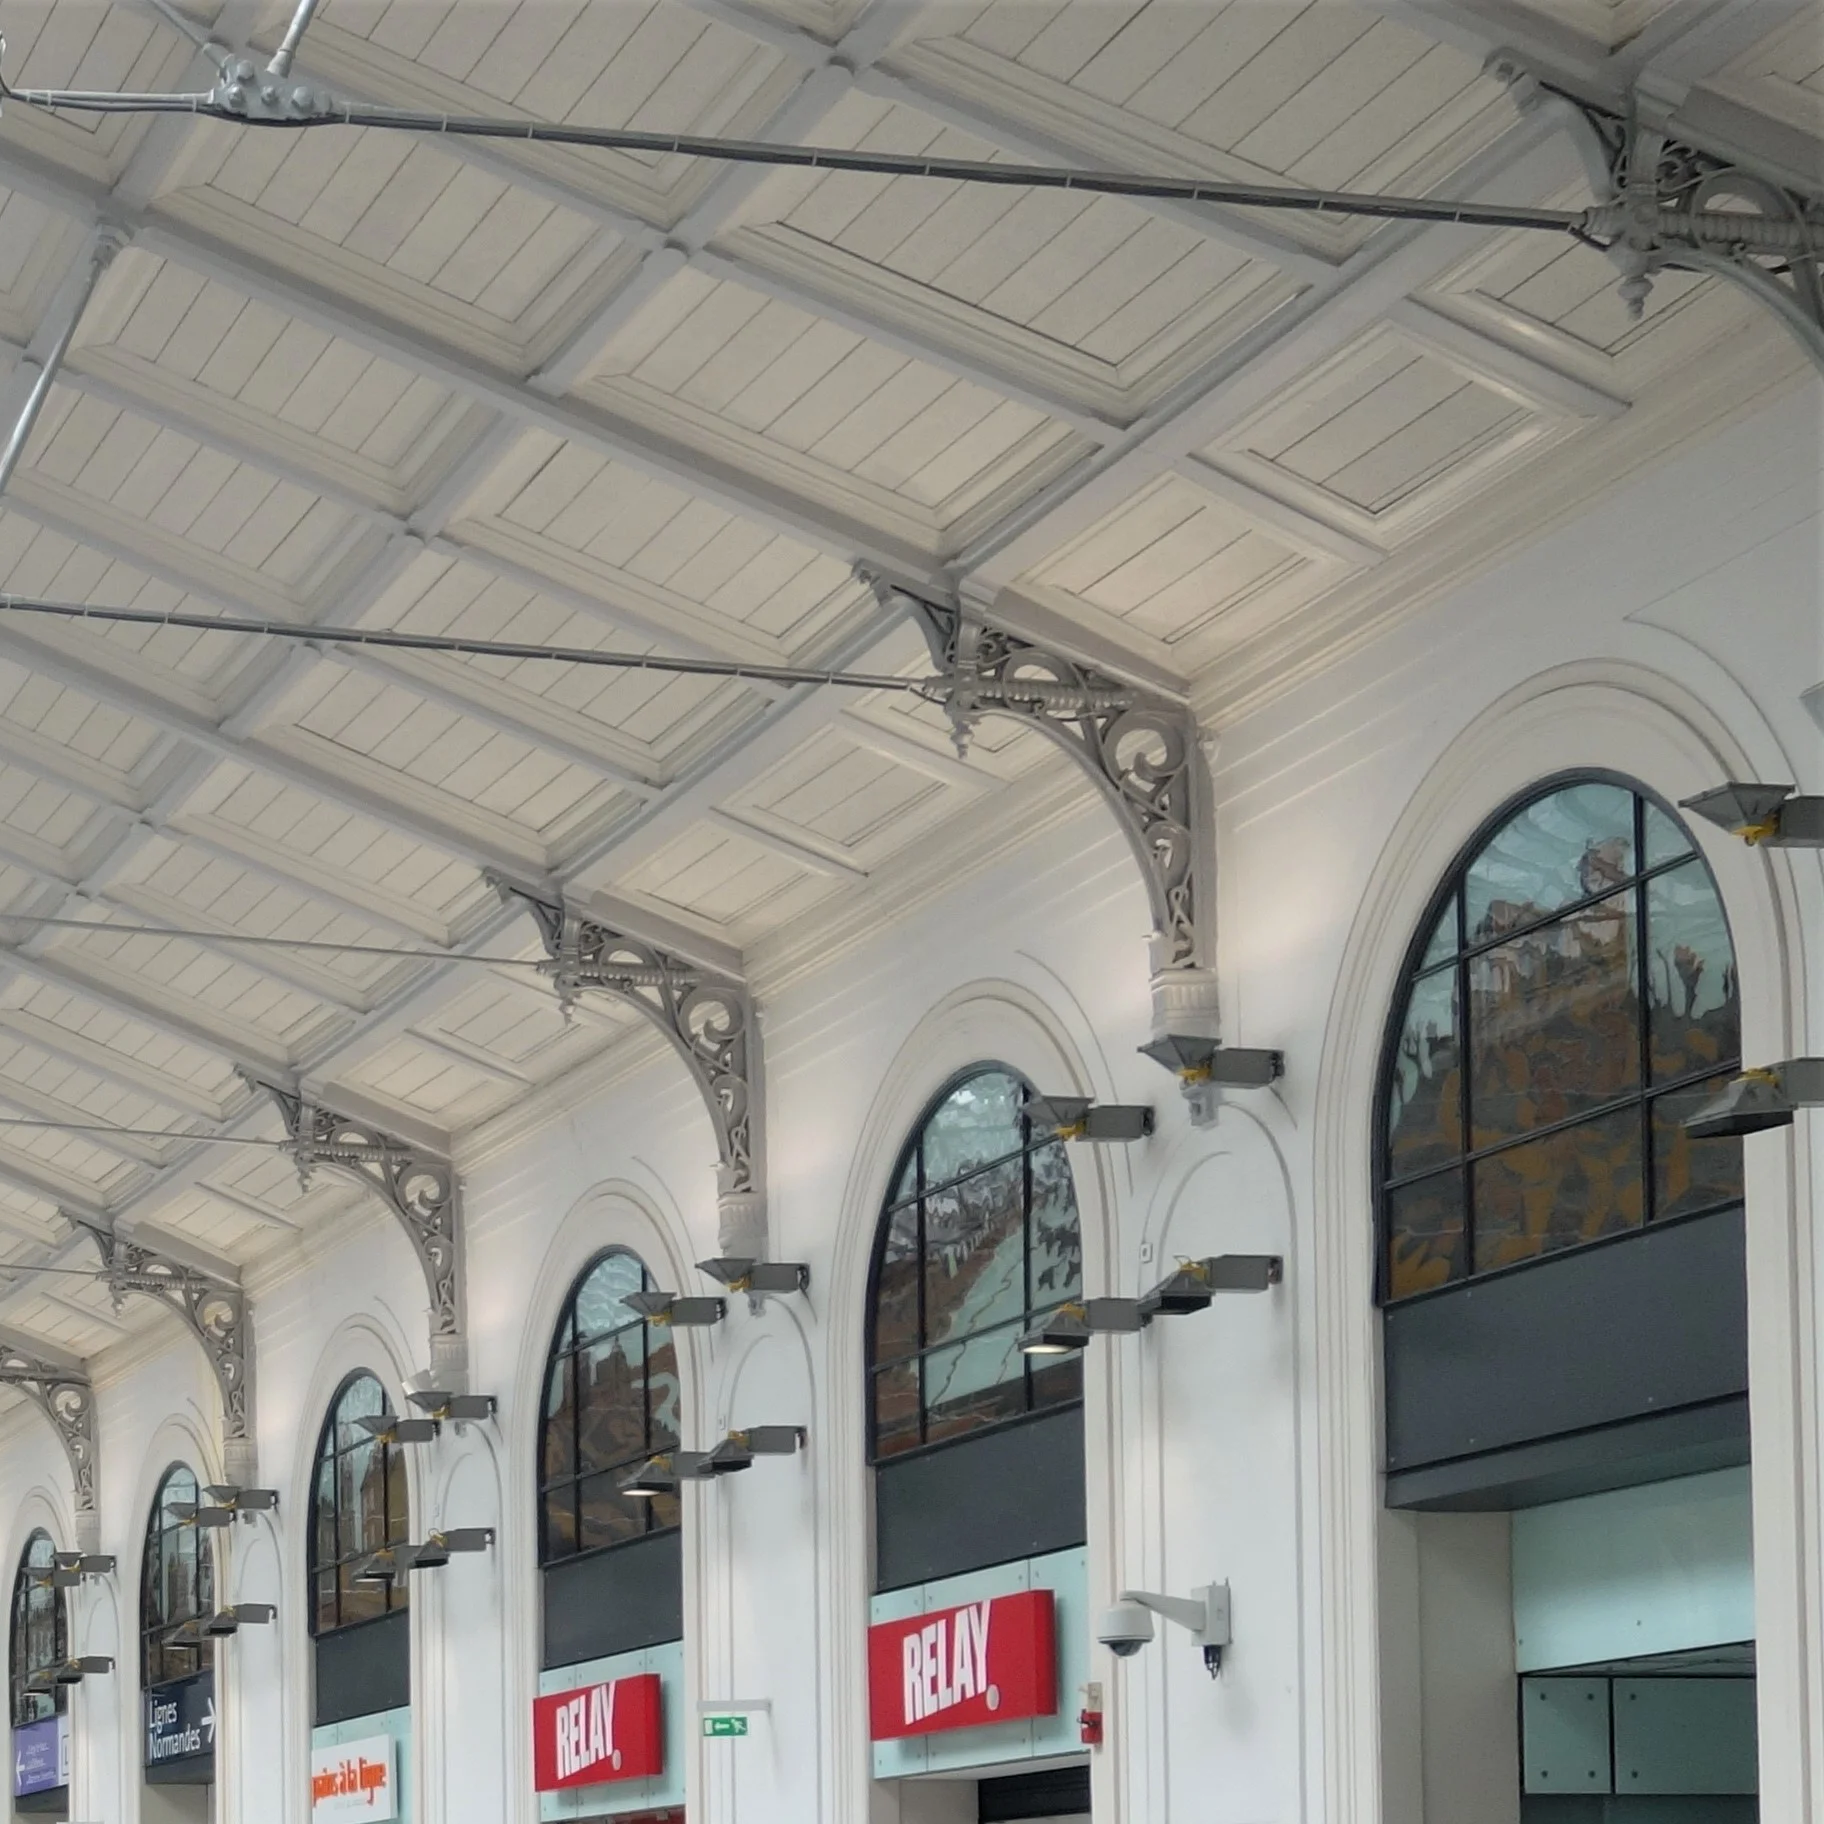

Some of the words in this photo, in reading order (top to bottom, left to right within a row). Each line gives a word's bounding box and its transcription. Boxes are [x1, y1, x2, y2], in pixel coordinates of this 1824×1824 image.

[903, 1602, 991, 1725] RELAY
[149, 1699, 178, 1734] Lignes
[149, 1723, 201, 1760] Normandes
[555, 1681, 616, 1780] RELAY
